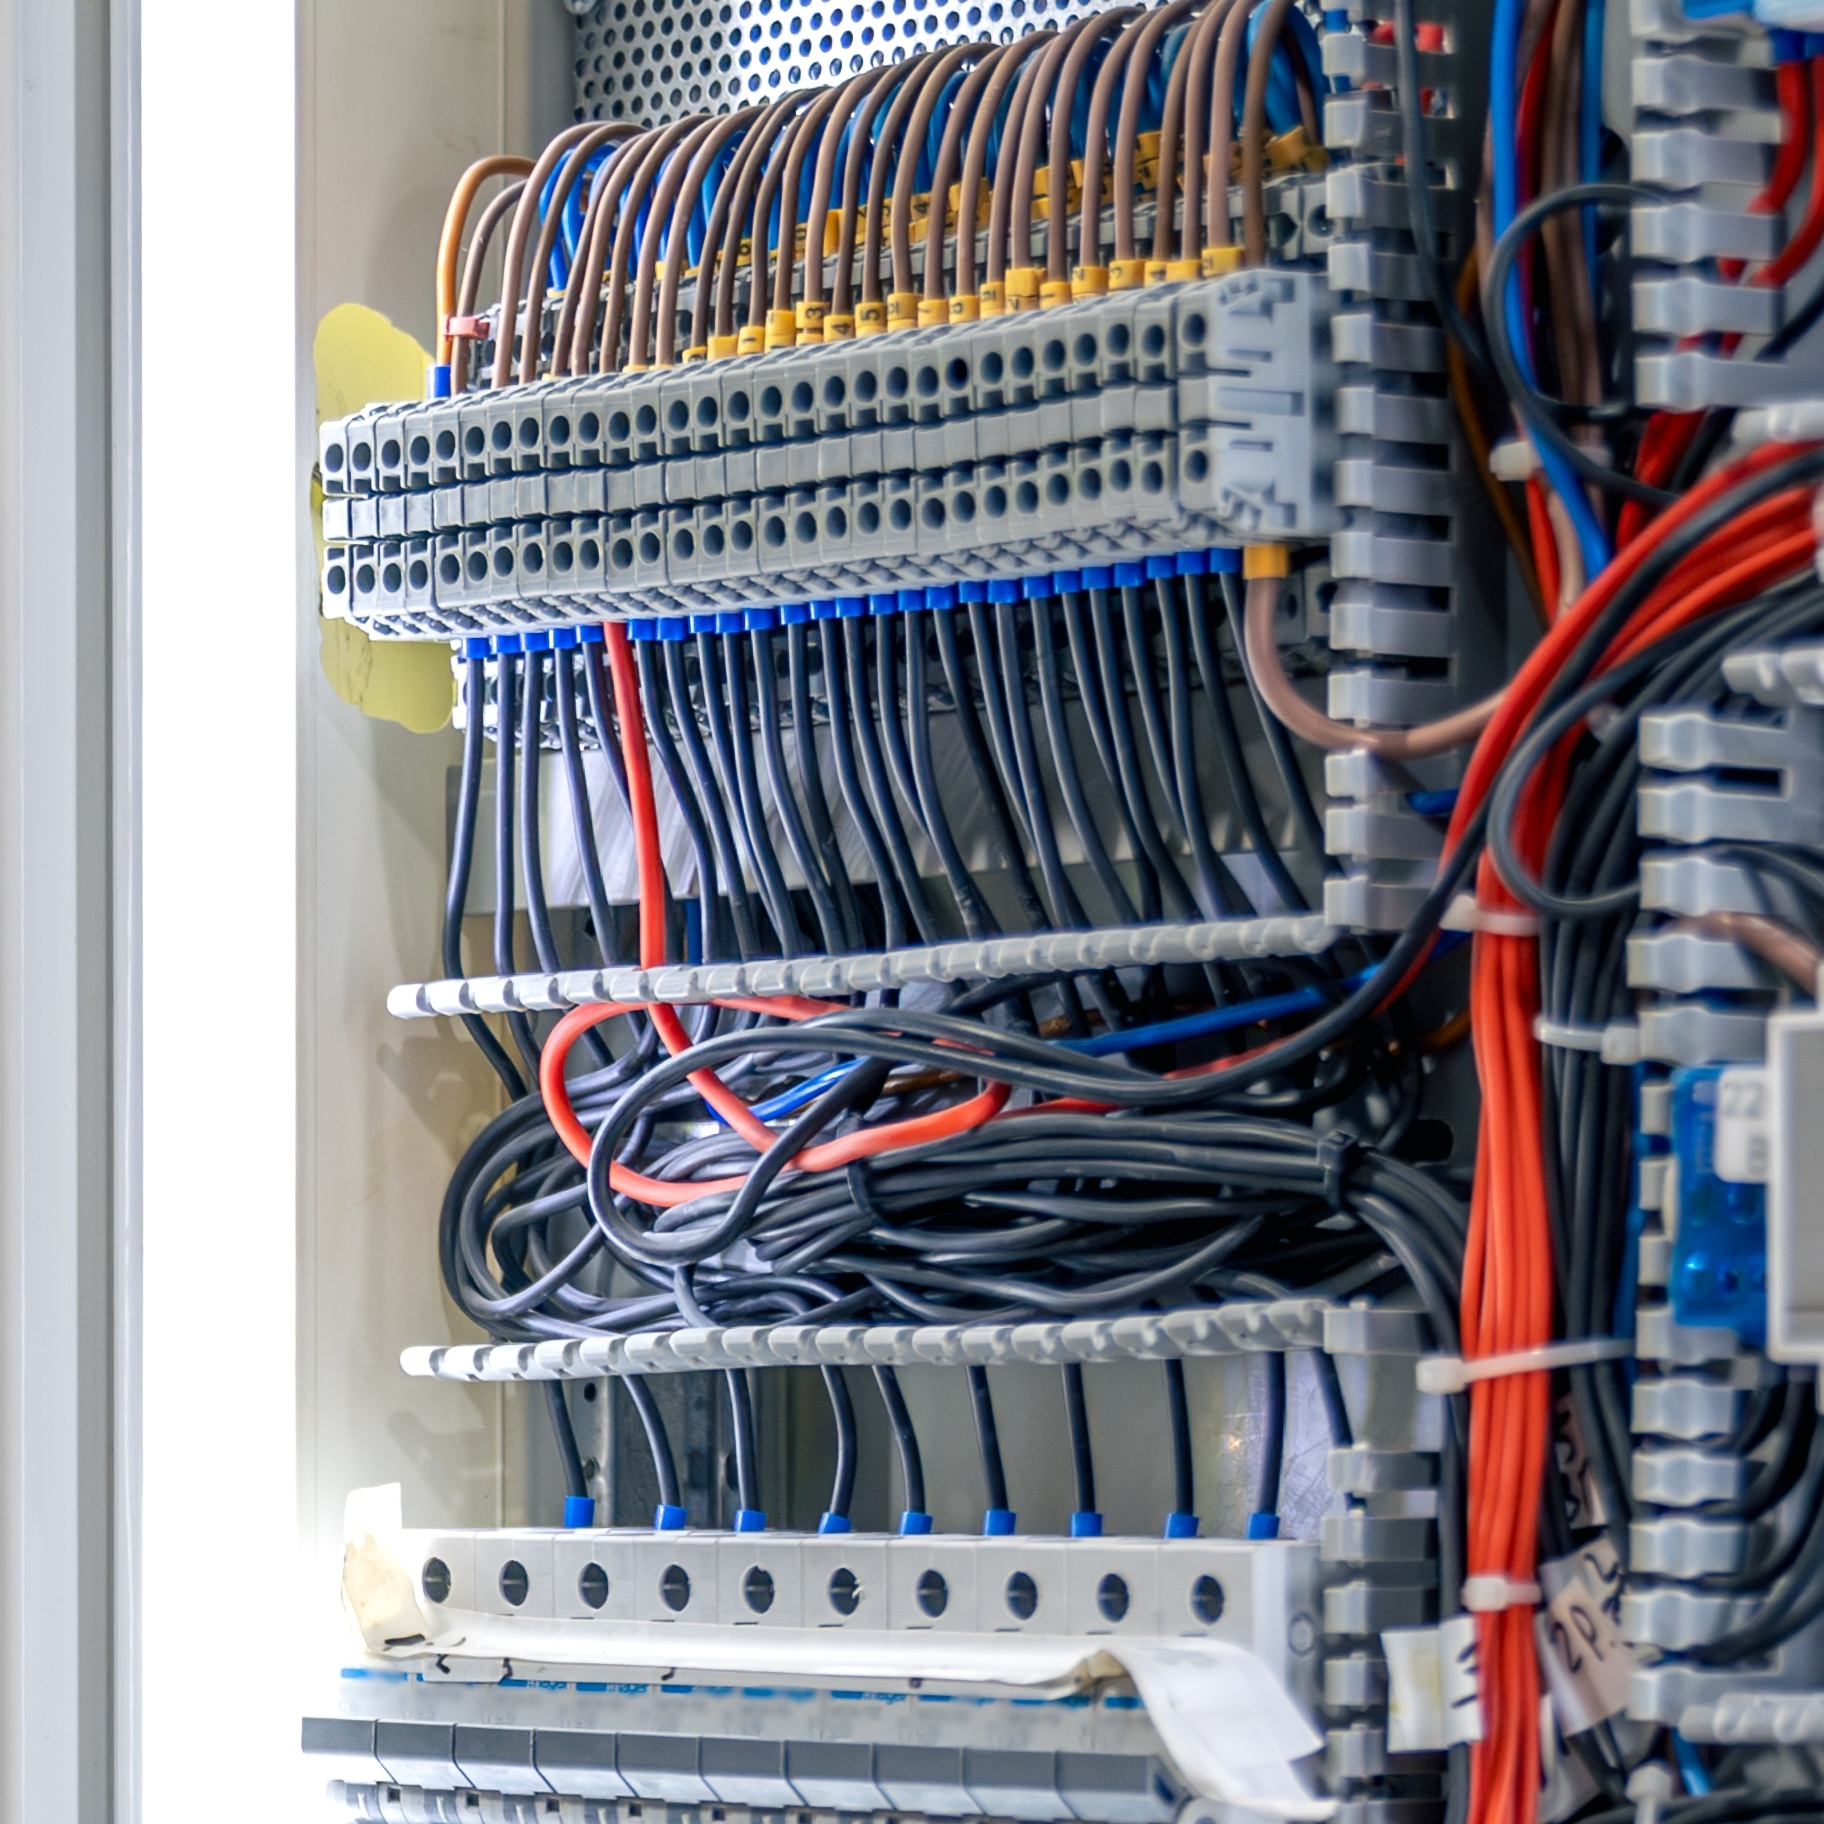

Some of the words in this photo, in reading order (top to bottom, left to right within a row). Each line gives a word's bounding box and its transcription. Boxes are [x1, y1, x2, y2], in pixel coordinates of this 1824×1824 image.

[805, 307, 824, 320] 3
[859, 309, 880, 322] 5
[832, 322, 851, 334] 4
